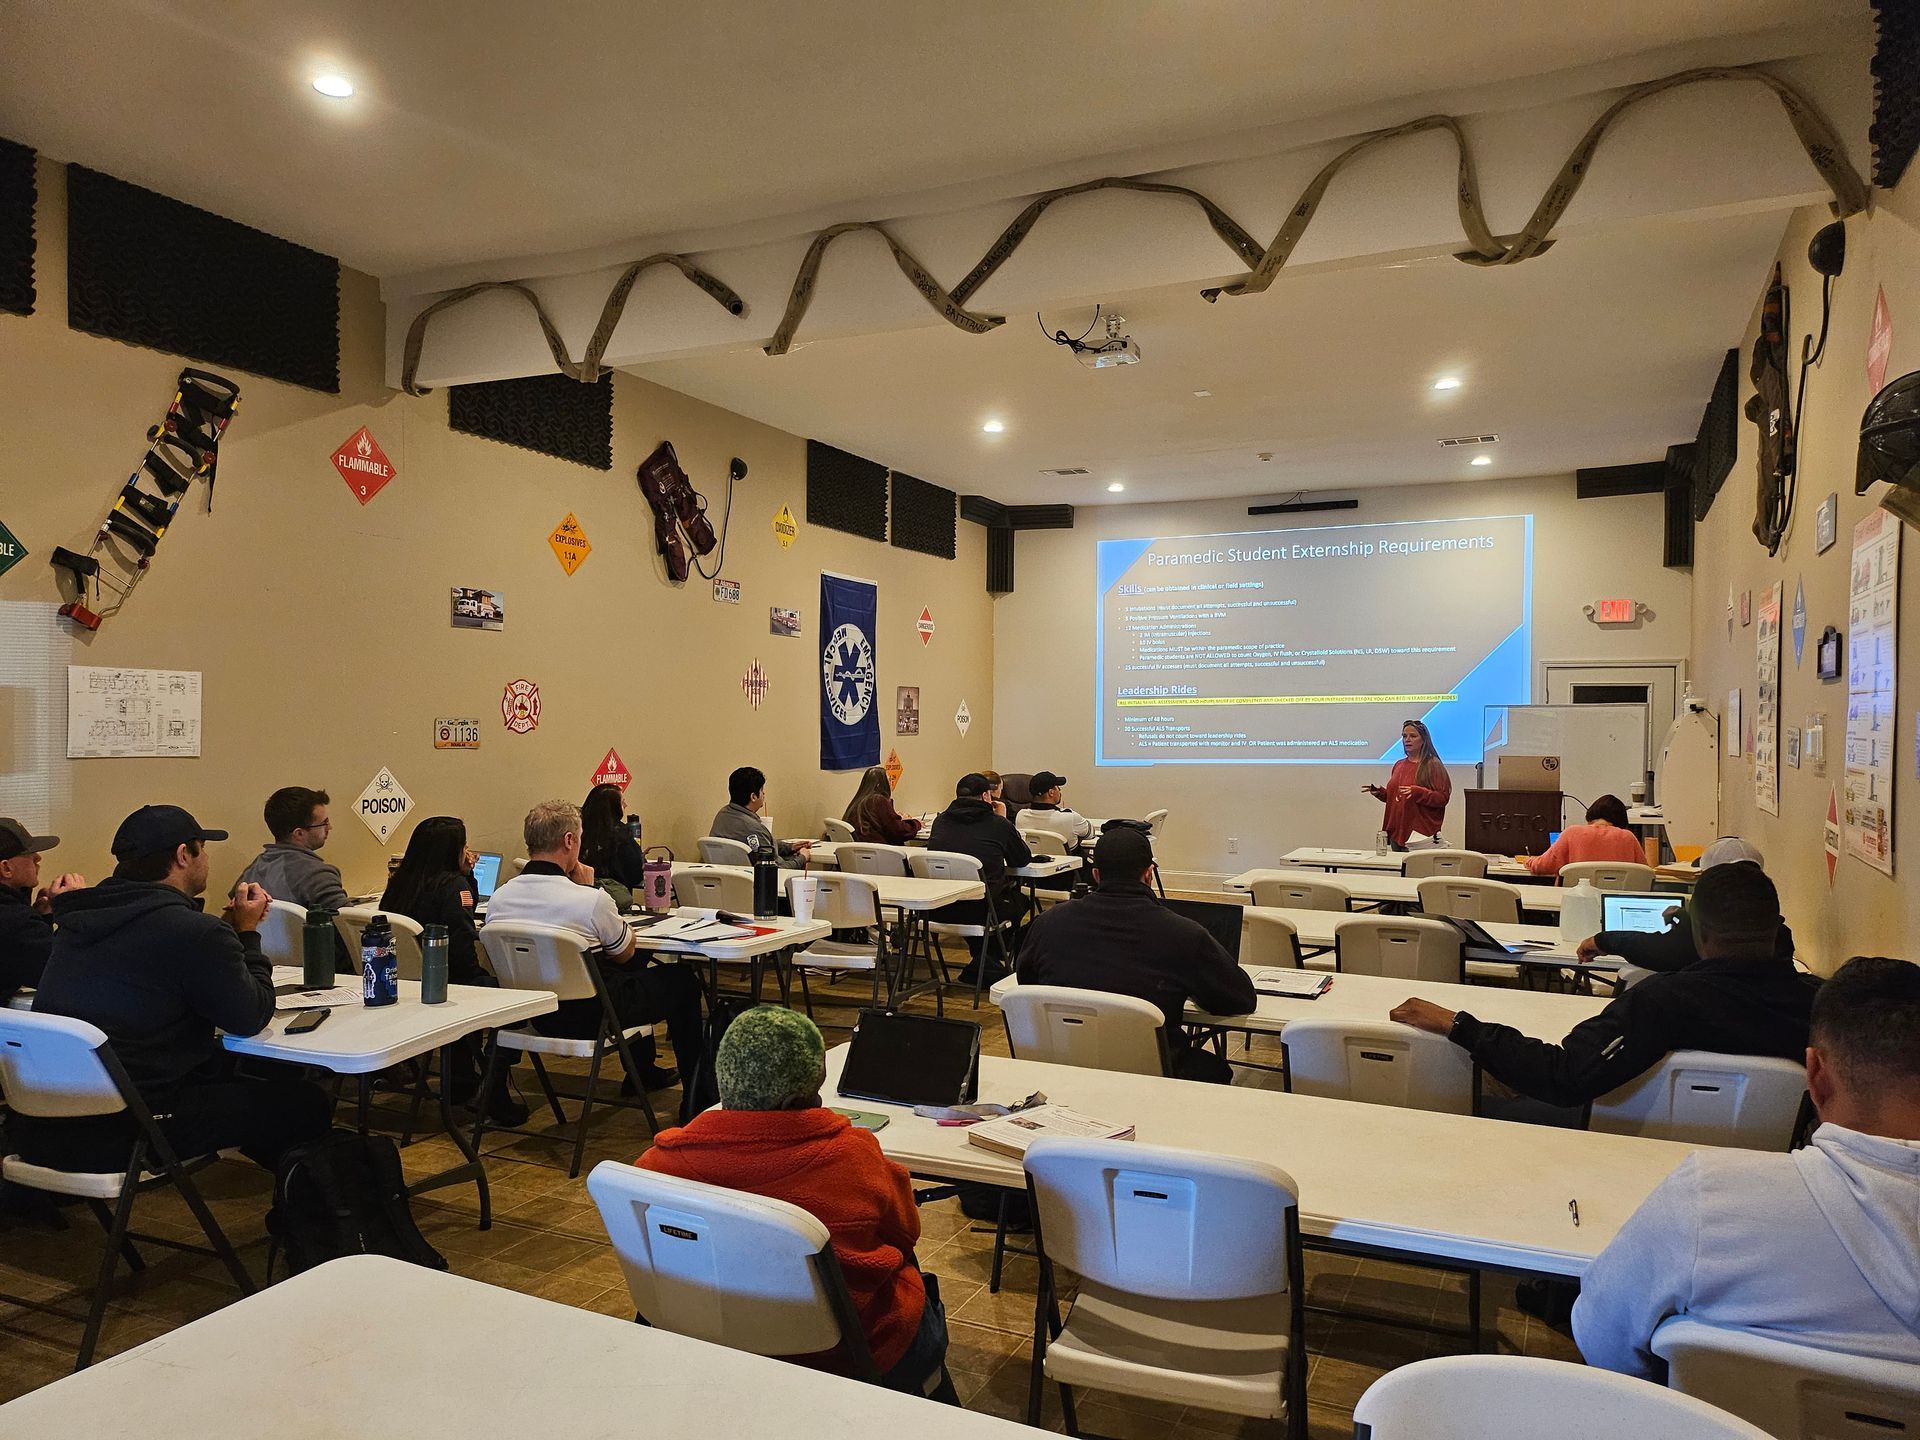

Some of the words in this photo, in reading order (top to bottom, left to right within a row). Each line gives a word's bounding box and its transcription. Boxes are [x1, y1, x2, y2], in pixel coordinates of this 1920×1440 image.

[338, 454, 388, 477] FLAMMABLE
[360, 485, 367, 496] 3
[555, 533, 586, 548] EXPLOSIVES
[1148, 550, 1223, 567] Paramedic
[1227, 547, 1288, 563] Student
[1291, 541, 1374, 560] Externship
[1378, 534, 1495, 555] Requirements
[1118, 583, 1142, 595] Skills
[1600, 599, 1631, 622] EXIT
[825, 627, 847, 665] MECAL
[515, 683, 530, 692] FIRE
[1117, 685, 1169, 696] Leadership
[1171, 684, 1198, 695] Rides
[454, 727, 479, 742] 1136
[596, 773, 628, 785] FLAMMABLE
[362, 797, 406, 815] POISON
[381, 825, 387, 835] 6
[663, 1226, 693, 1239] LIFETIME
